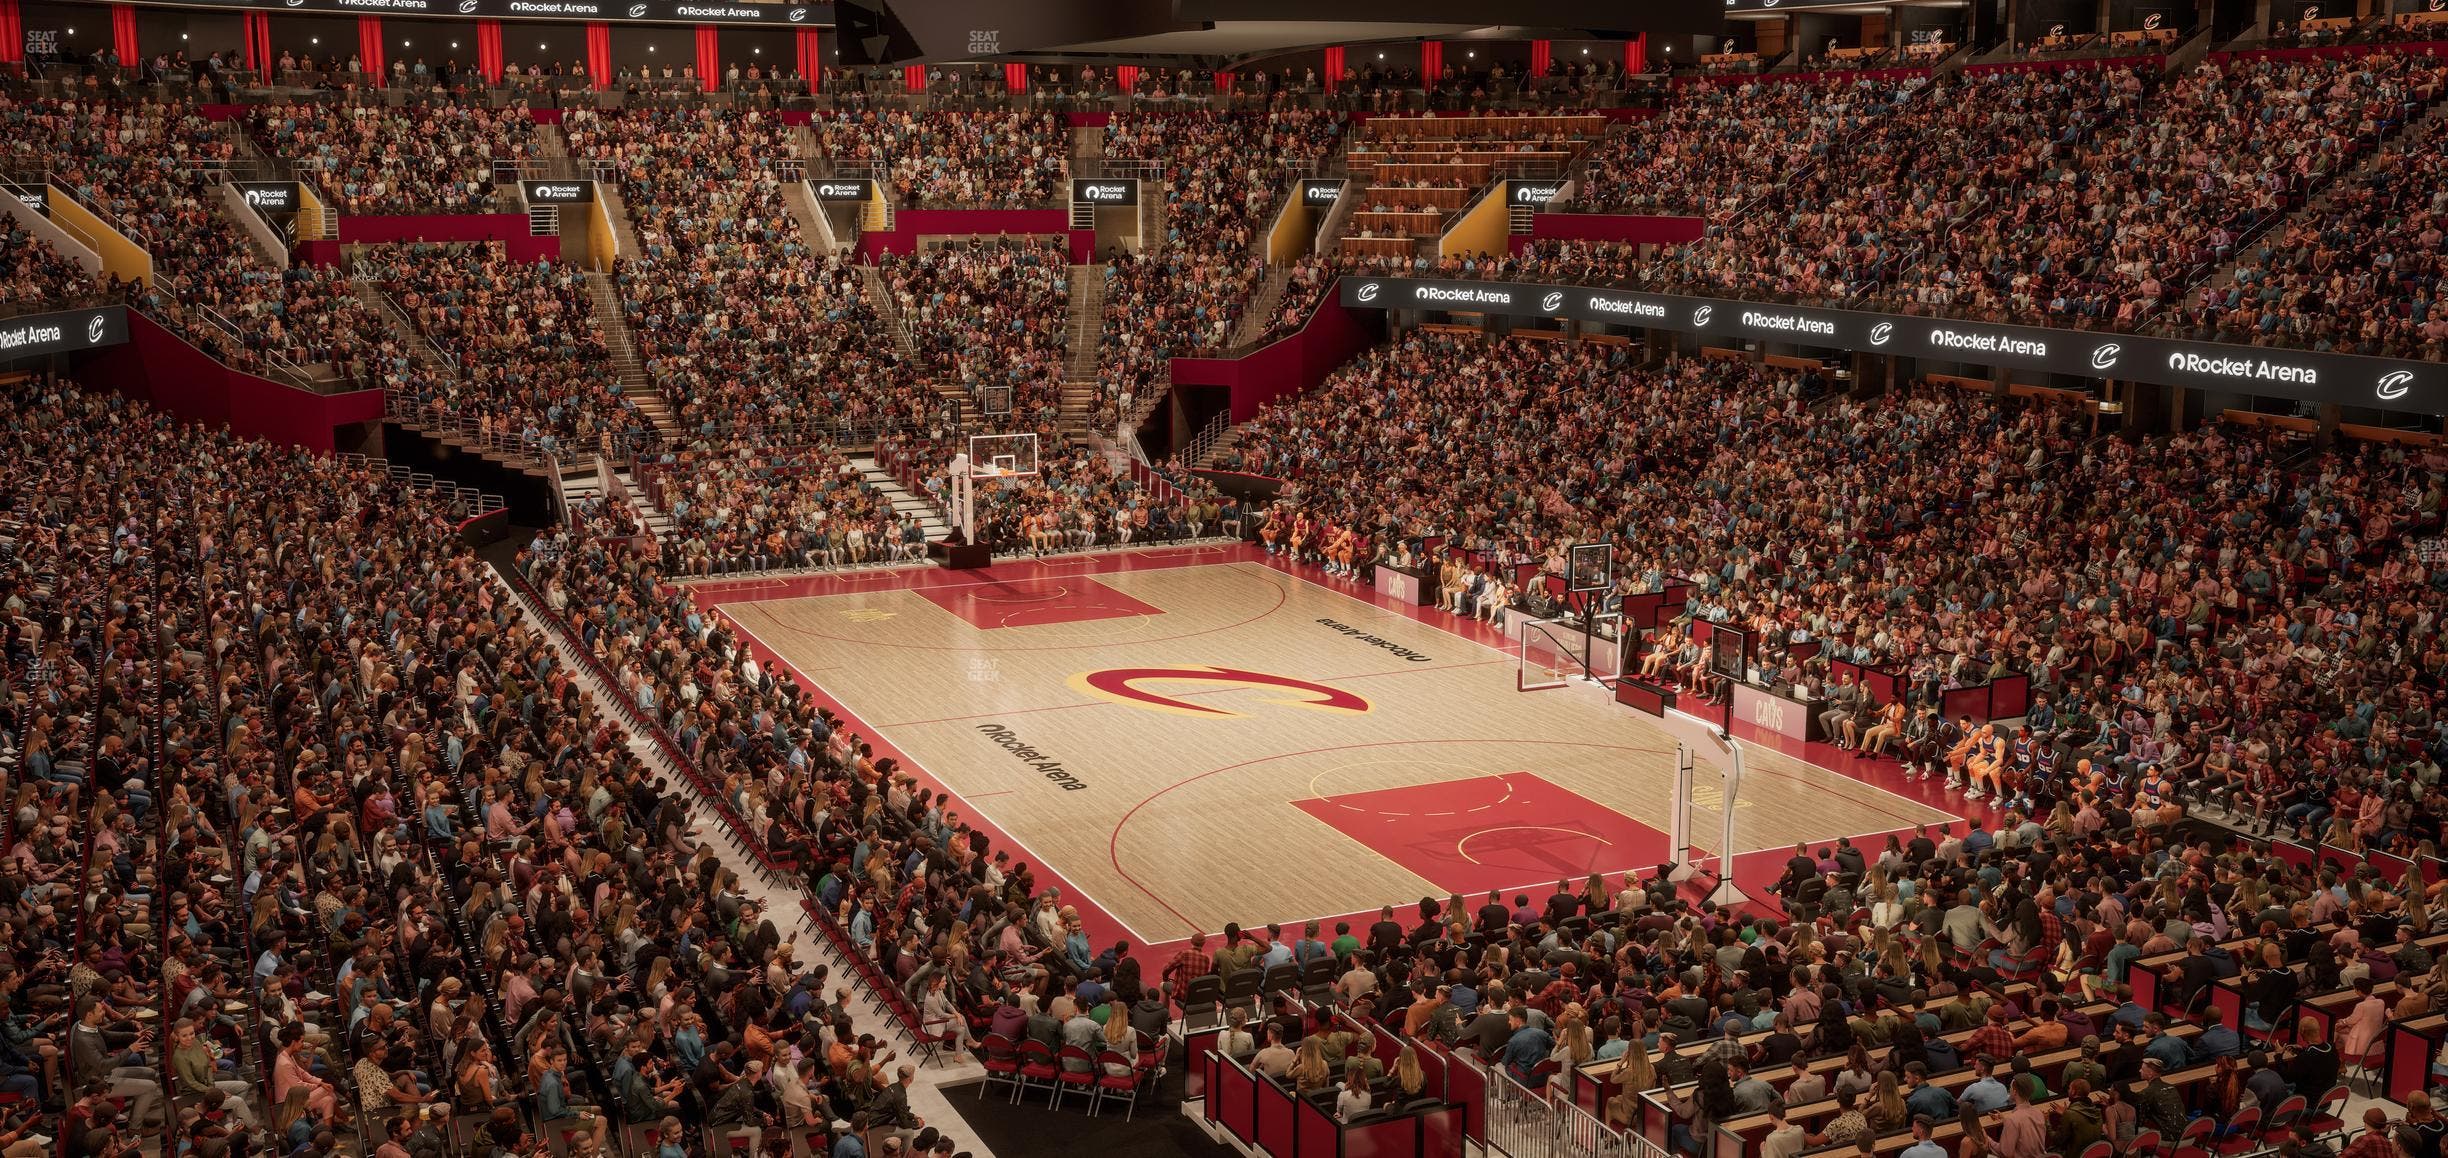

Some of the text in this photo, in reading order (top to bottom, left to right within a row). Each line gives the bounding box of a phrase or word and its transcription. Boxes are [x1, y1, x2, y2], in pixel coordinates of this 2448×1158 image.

[521, 2, 598, 13] Rocket Arena
[688, 6, 760, 17] Rocket Arena
[260, 190, 288, 198] Rocket
[1100, 185, 1126, 193] Rocket
[1531, 187, 1556, 195] Rocket
[1429, 287, 1511, 303] Rocket Arena
[1599, 297, 1665, 317] Rocket Arena
[1753, 312, 1834, 334] Rocket Arena
[2, 326, 61, 349] Rocket Arena
[1943, 330, 2046, 356] Rocket Arena
[2186, 353, 2317, 384] Rocket Arena
[1388, 574, 1406, 600] CAVS
[1315, 618, 1420, 657] Rocket Arena
[1755, 697, 1784, 731] CAVS
[985, 730, 1088, 791] Rocket Arena
